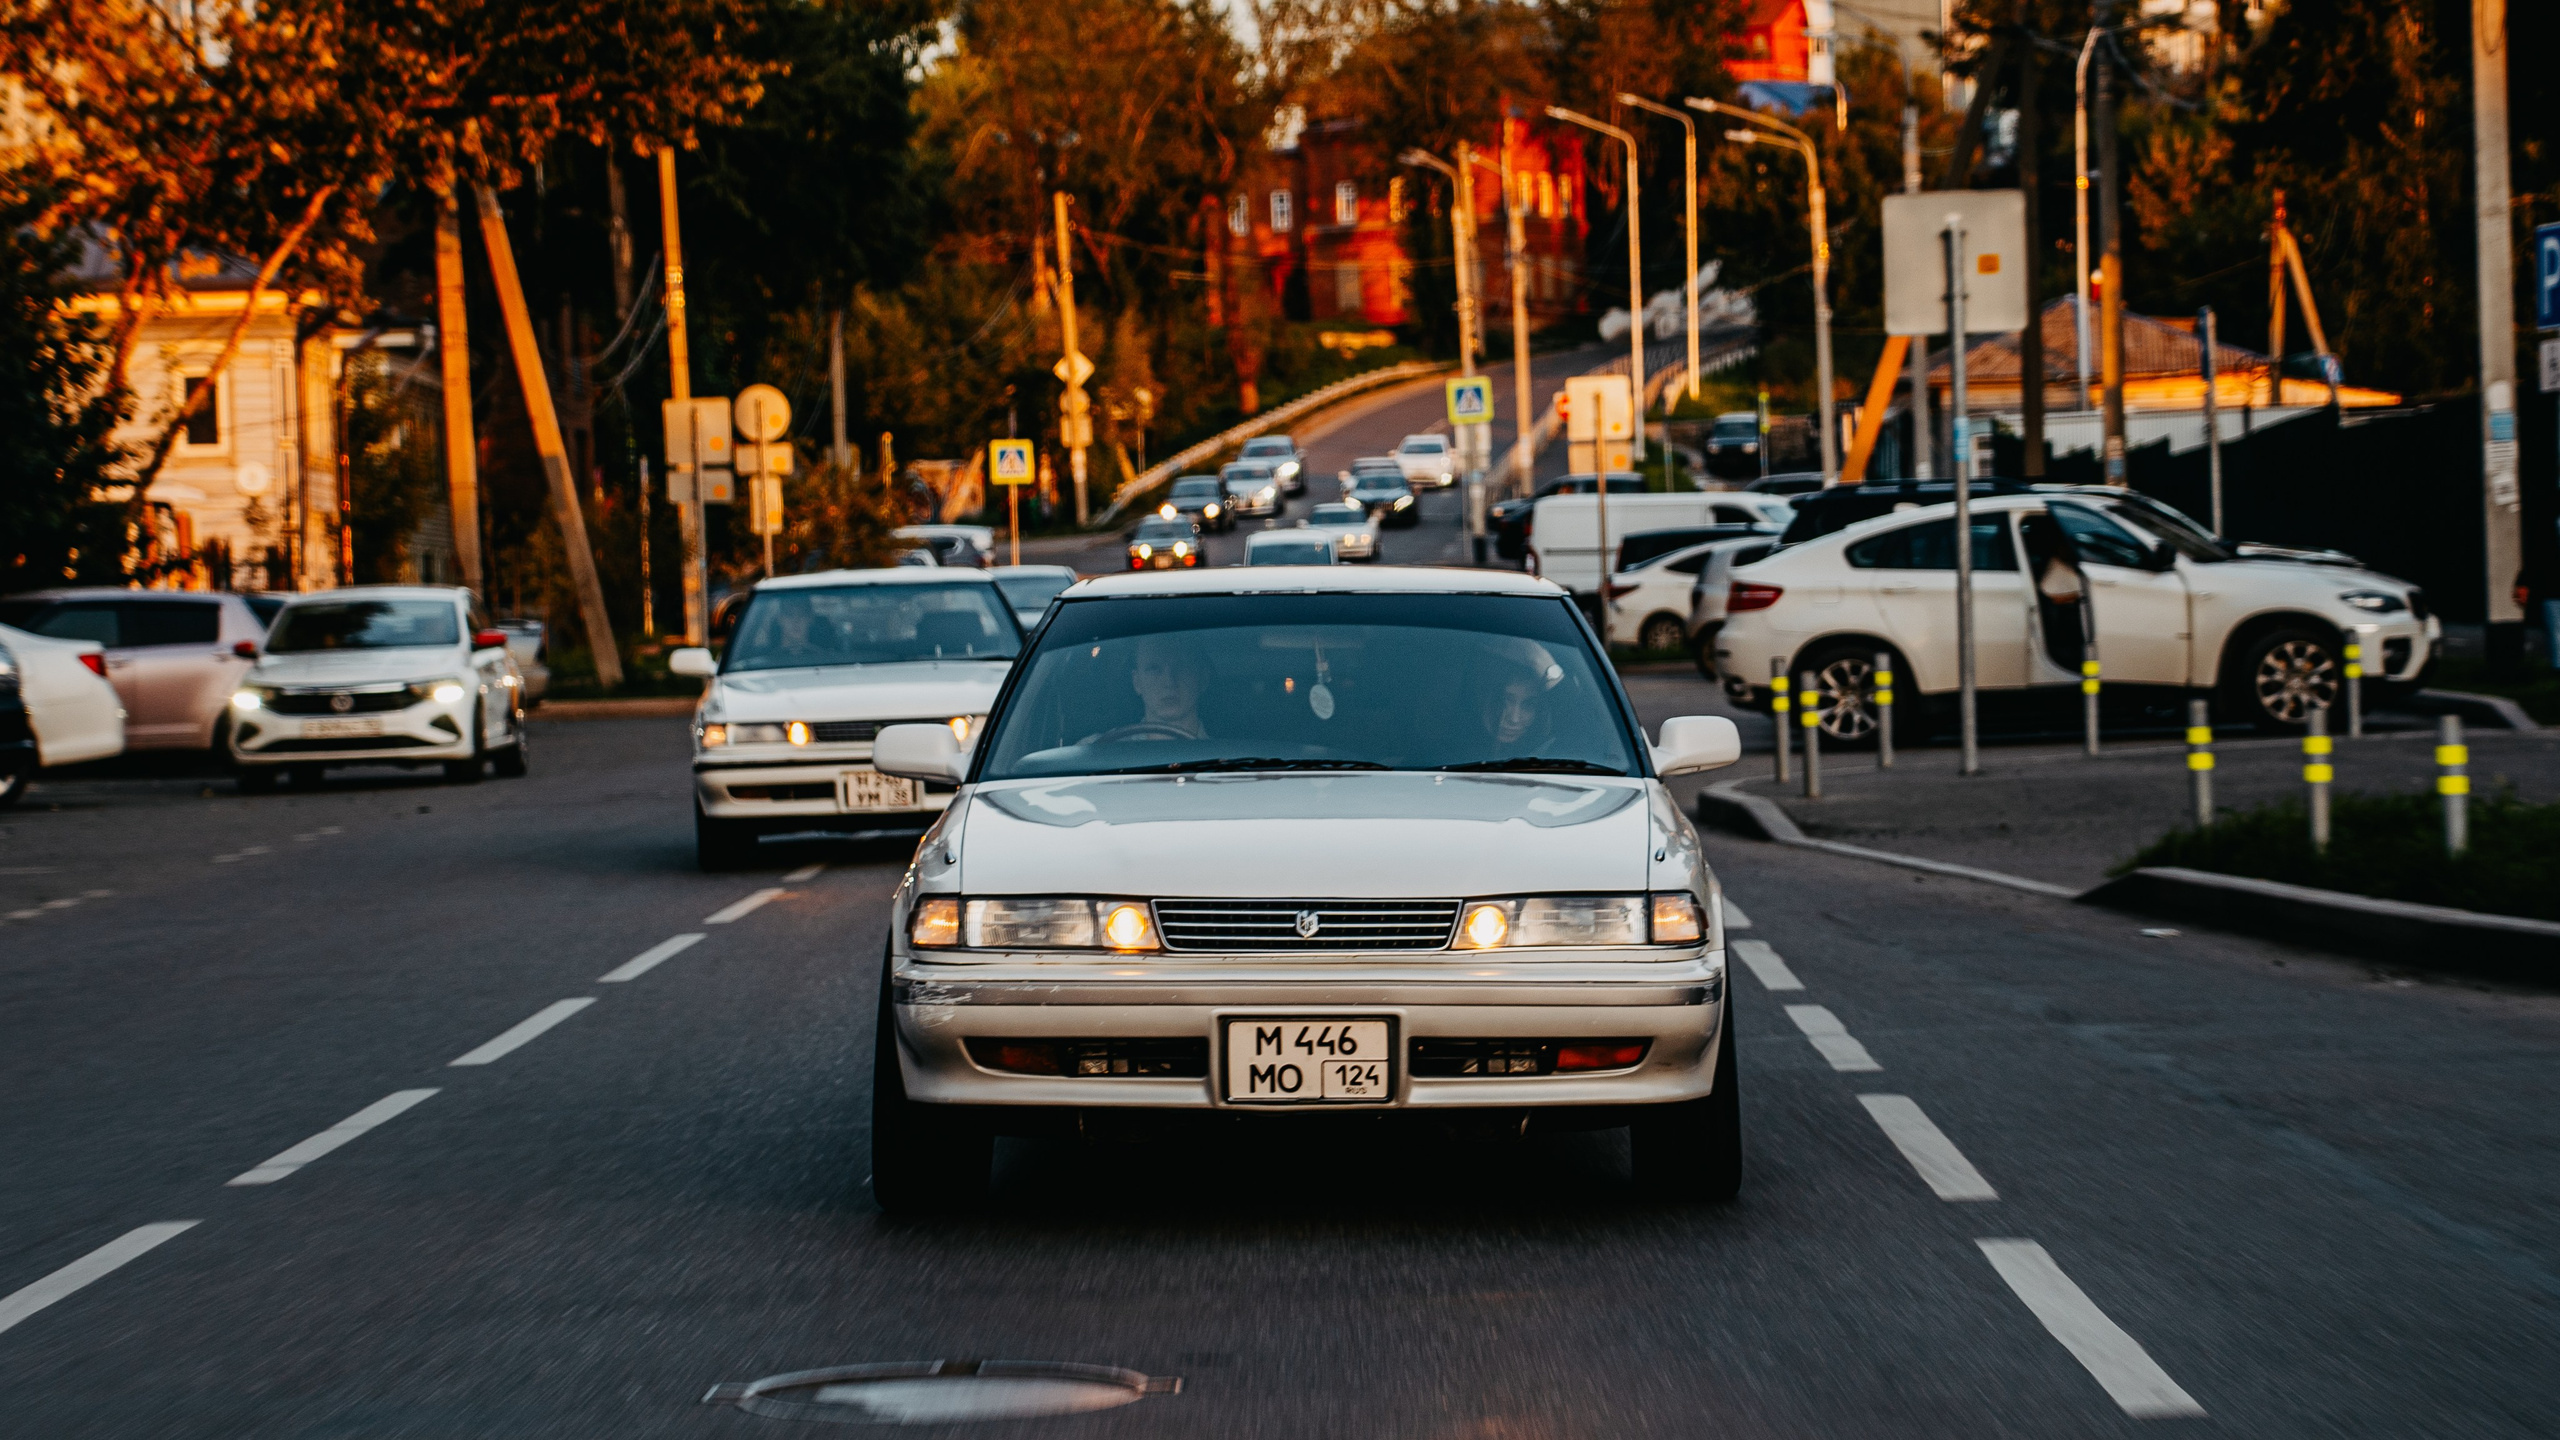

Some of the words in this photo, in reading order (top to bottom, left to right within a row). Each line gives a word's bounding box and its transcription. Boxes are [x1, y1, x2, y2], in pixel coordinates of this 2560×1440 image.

[1295, 1026, 1357, 1055] 446
[1335, 1065, 1379, 1086] 124
[1345, 1087, 1367, 1095] RUS
